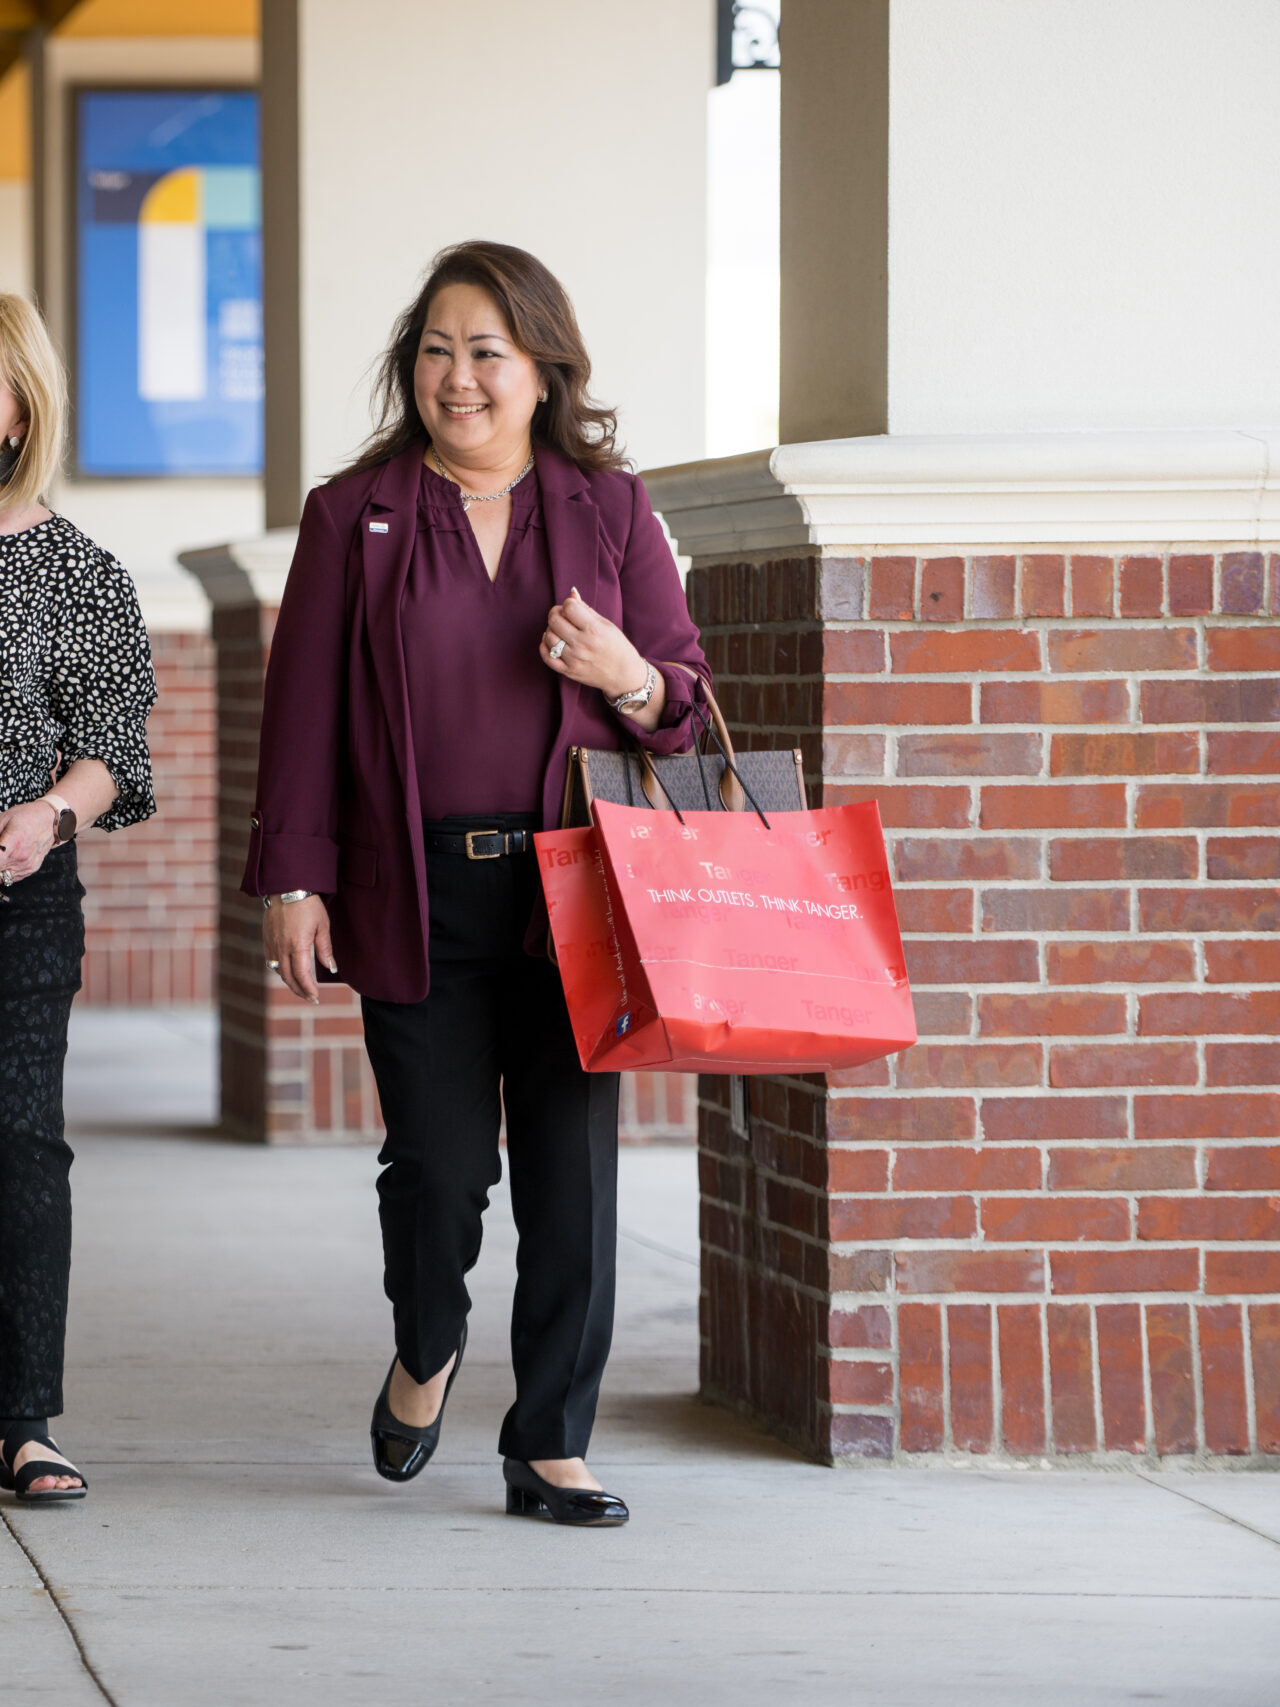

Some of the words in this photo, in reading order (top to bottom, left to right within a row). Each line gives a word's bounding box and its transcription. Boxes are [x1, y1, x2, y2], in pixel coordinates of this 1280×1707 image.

[647, 888, 696, 904] THINK
[697, 888, 759, 909] OUTLETS.
[760, 895, 803, 914] THINK
[802, 900, 864, 920] TANGER.
